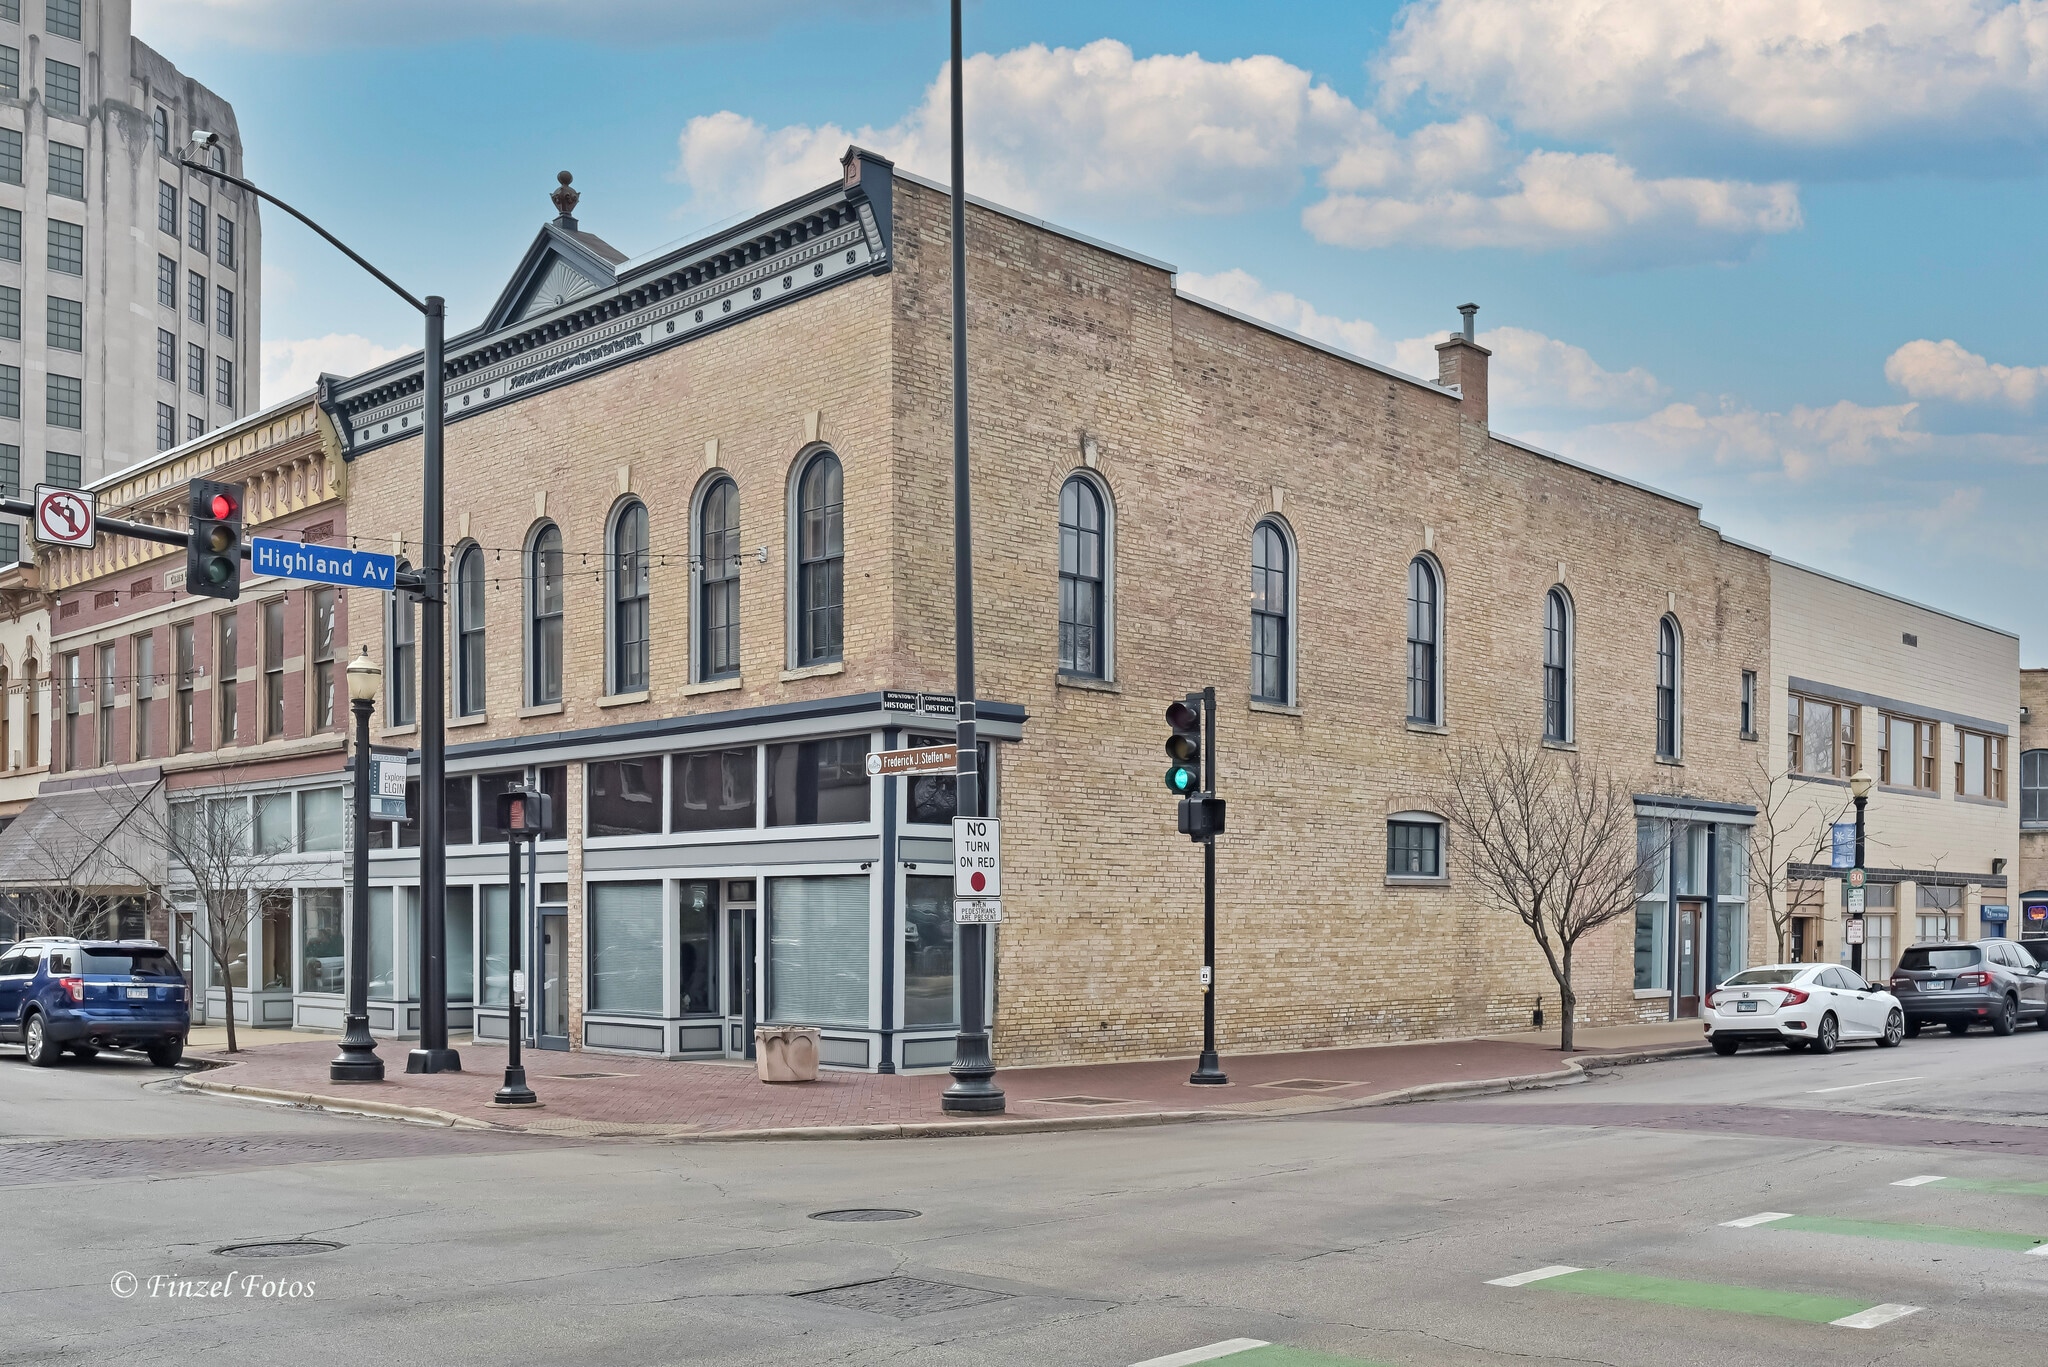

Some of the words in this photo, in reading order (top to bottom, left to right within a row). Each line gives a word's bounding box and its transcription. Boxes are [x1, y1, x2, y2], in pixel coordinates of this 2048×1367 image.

[259, 547, 353, 575] Highland
[362, 561, 389, 581] Av
[887, 692, 915, 700] DOWNTOWN
[924, 695, 954, 703] COMMERCIAL
[884, 701, 916, 710] HISTORIC
[925, 704, 955, 713] DISTRICT
[884, 755, 914, 768] Frederick
[921, 751, 944, 764] Steffen
[384, 773, 405, 782] Explore
[384, 782, 405, 794] ELGIN
[967, 822, 987, 836] NO
[965, 841, 990, 852] TURN
[960, 857, 973, 868] ON
[977, 857, 995, 868] RED
[1851, 873, 1863, 881] 30
